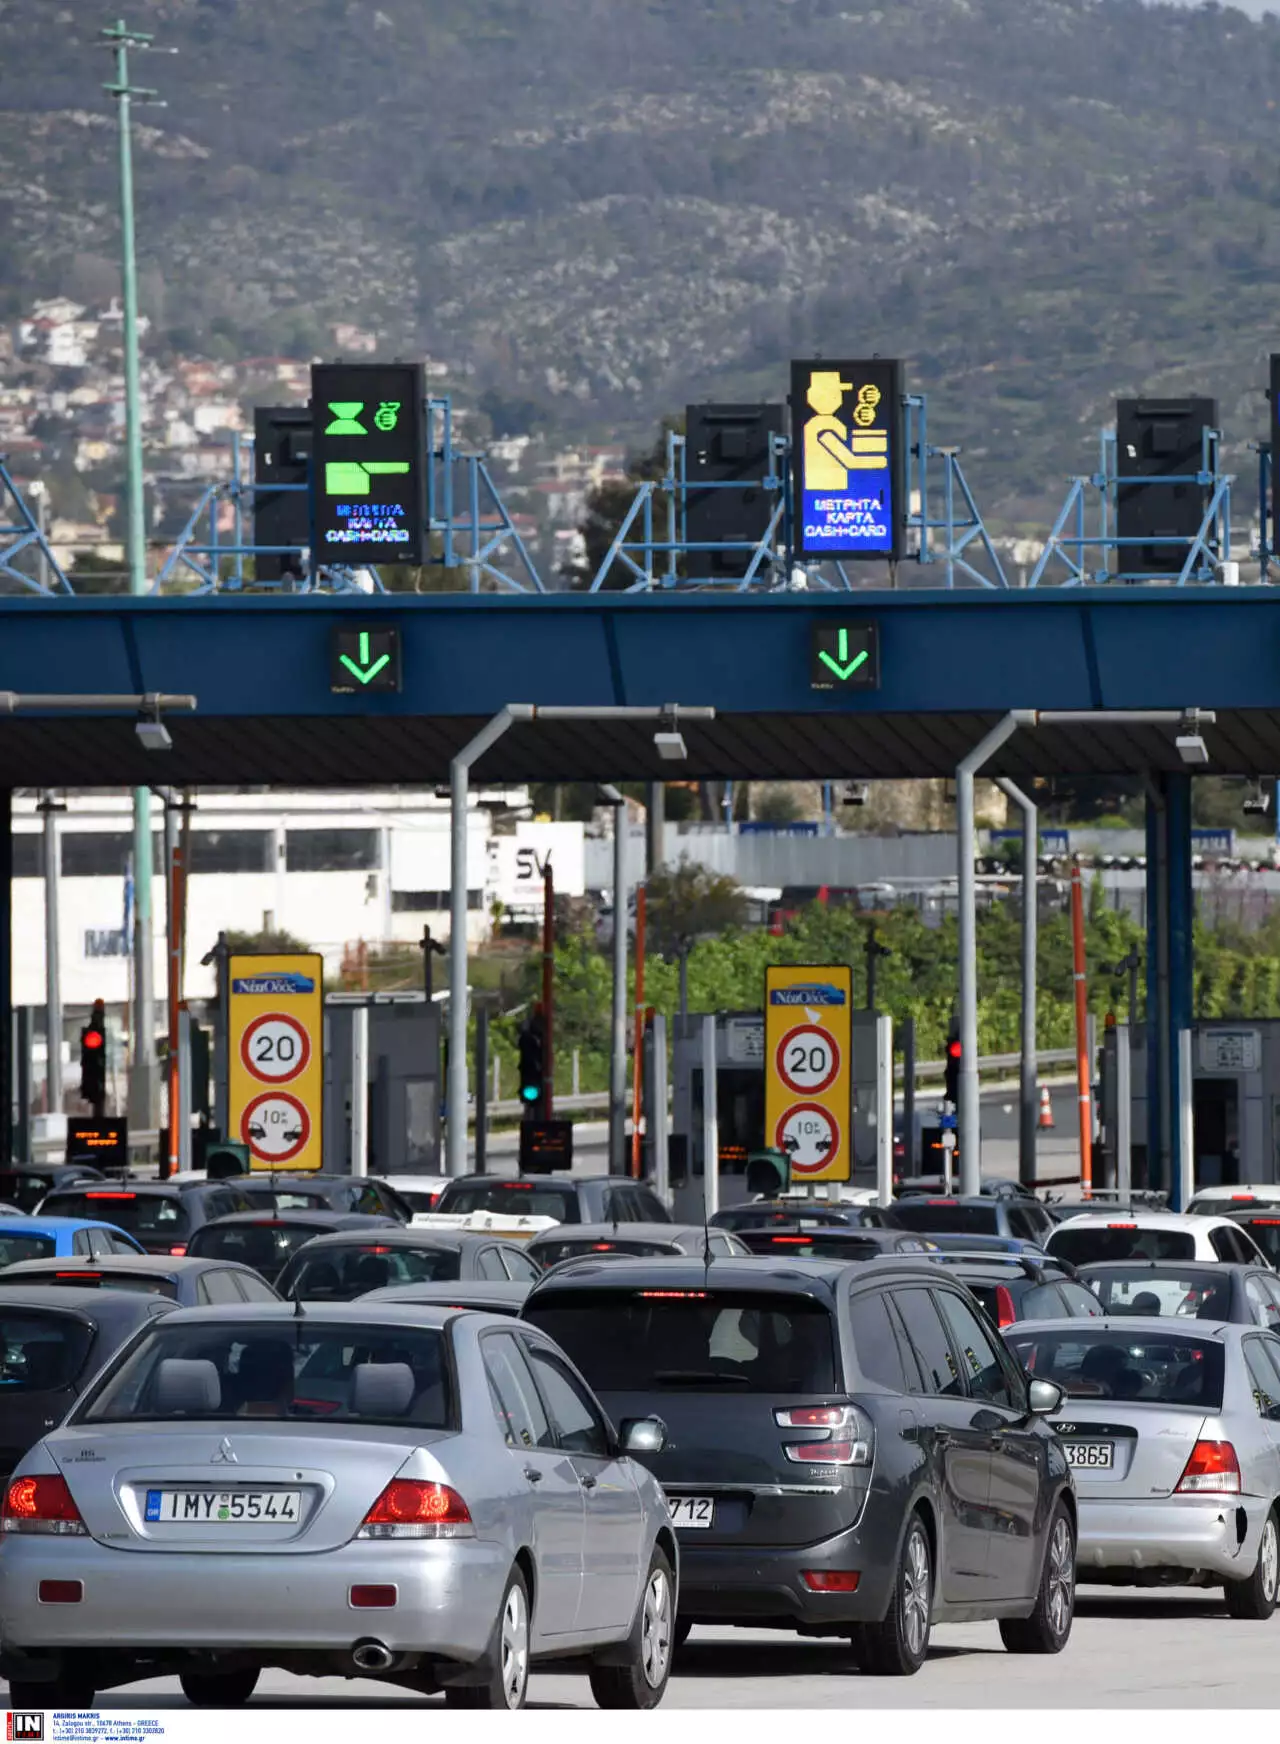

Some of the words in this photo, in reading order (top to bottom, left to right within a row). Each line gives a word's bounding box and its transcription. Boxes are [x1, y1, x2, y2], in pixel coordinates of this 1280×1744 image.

[256, 1035, 295, 1062] 20
[790, 1046, 826, 1073] 20
[263, 1109, 280, 1124] 10
[797, 1120, 814, 1135] 10
[1064, 1444, 1109, 1465] 3865
[669, 1498, 710, 1520] 712
